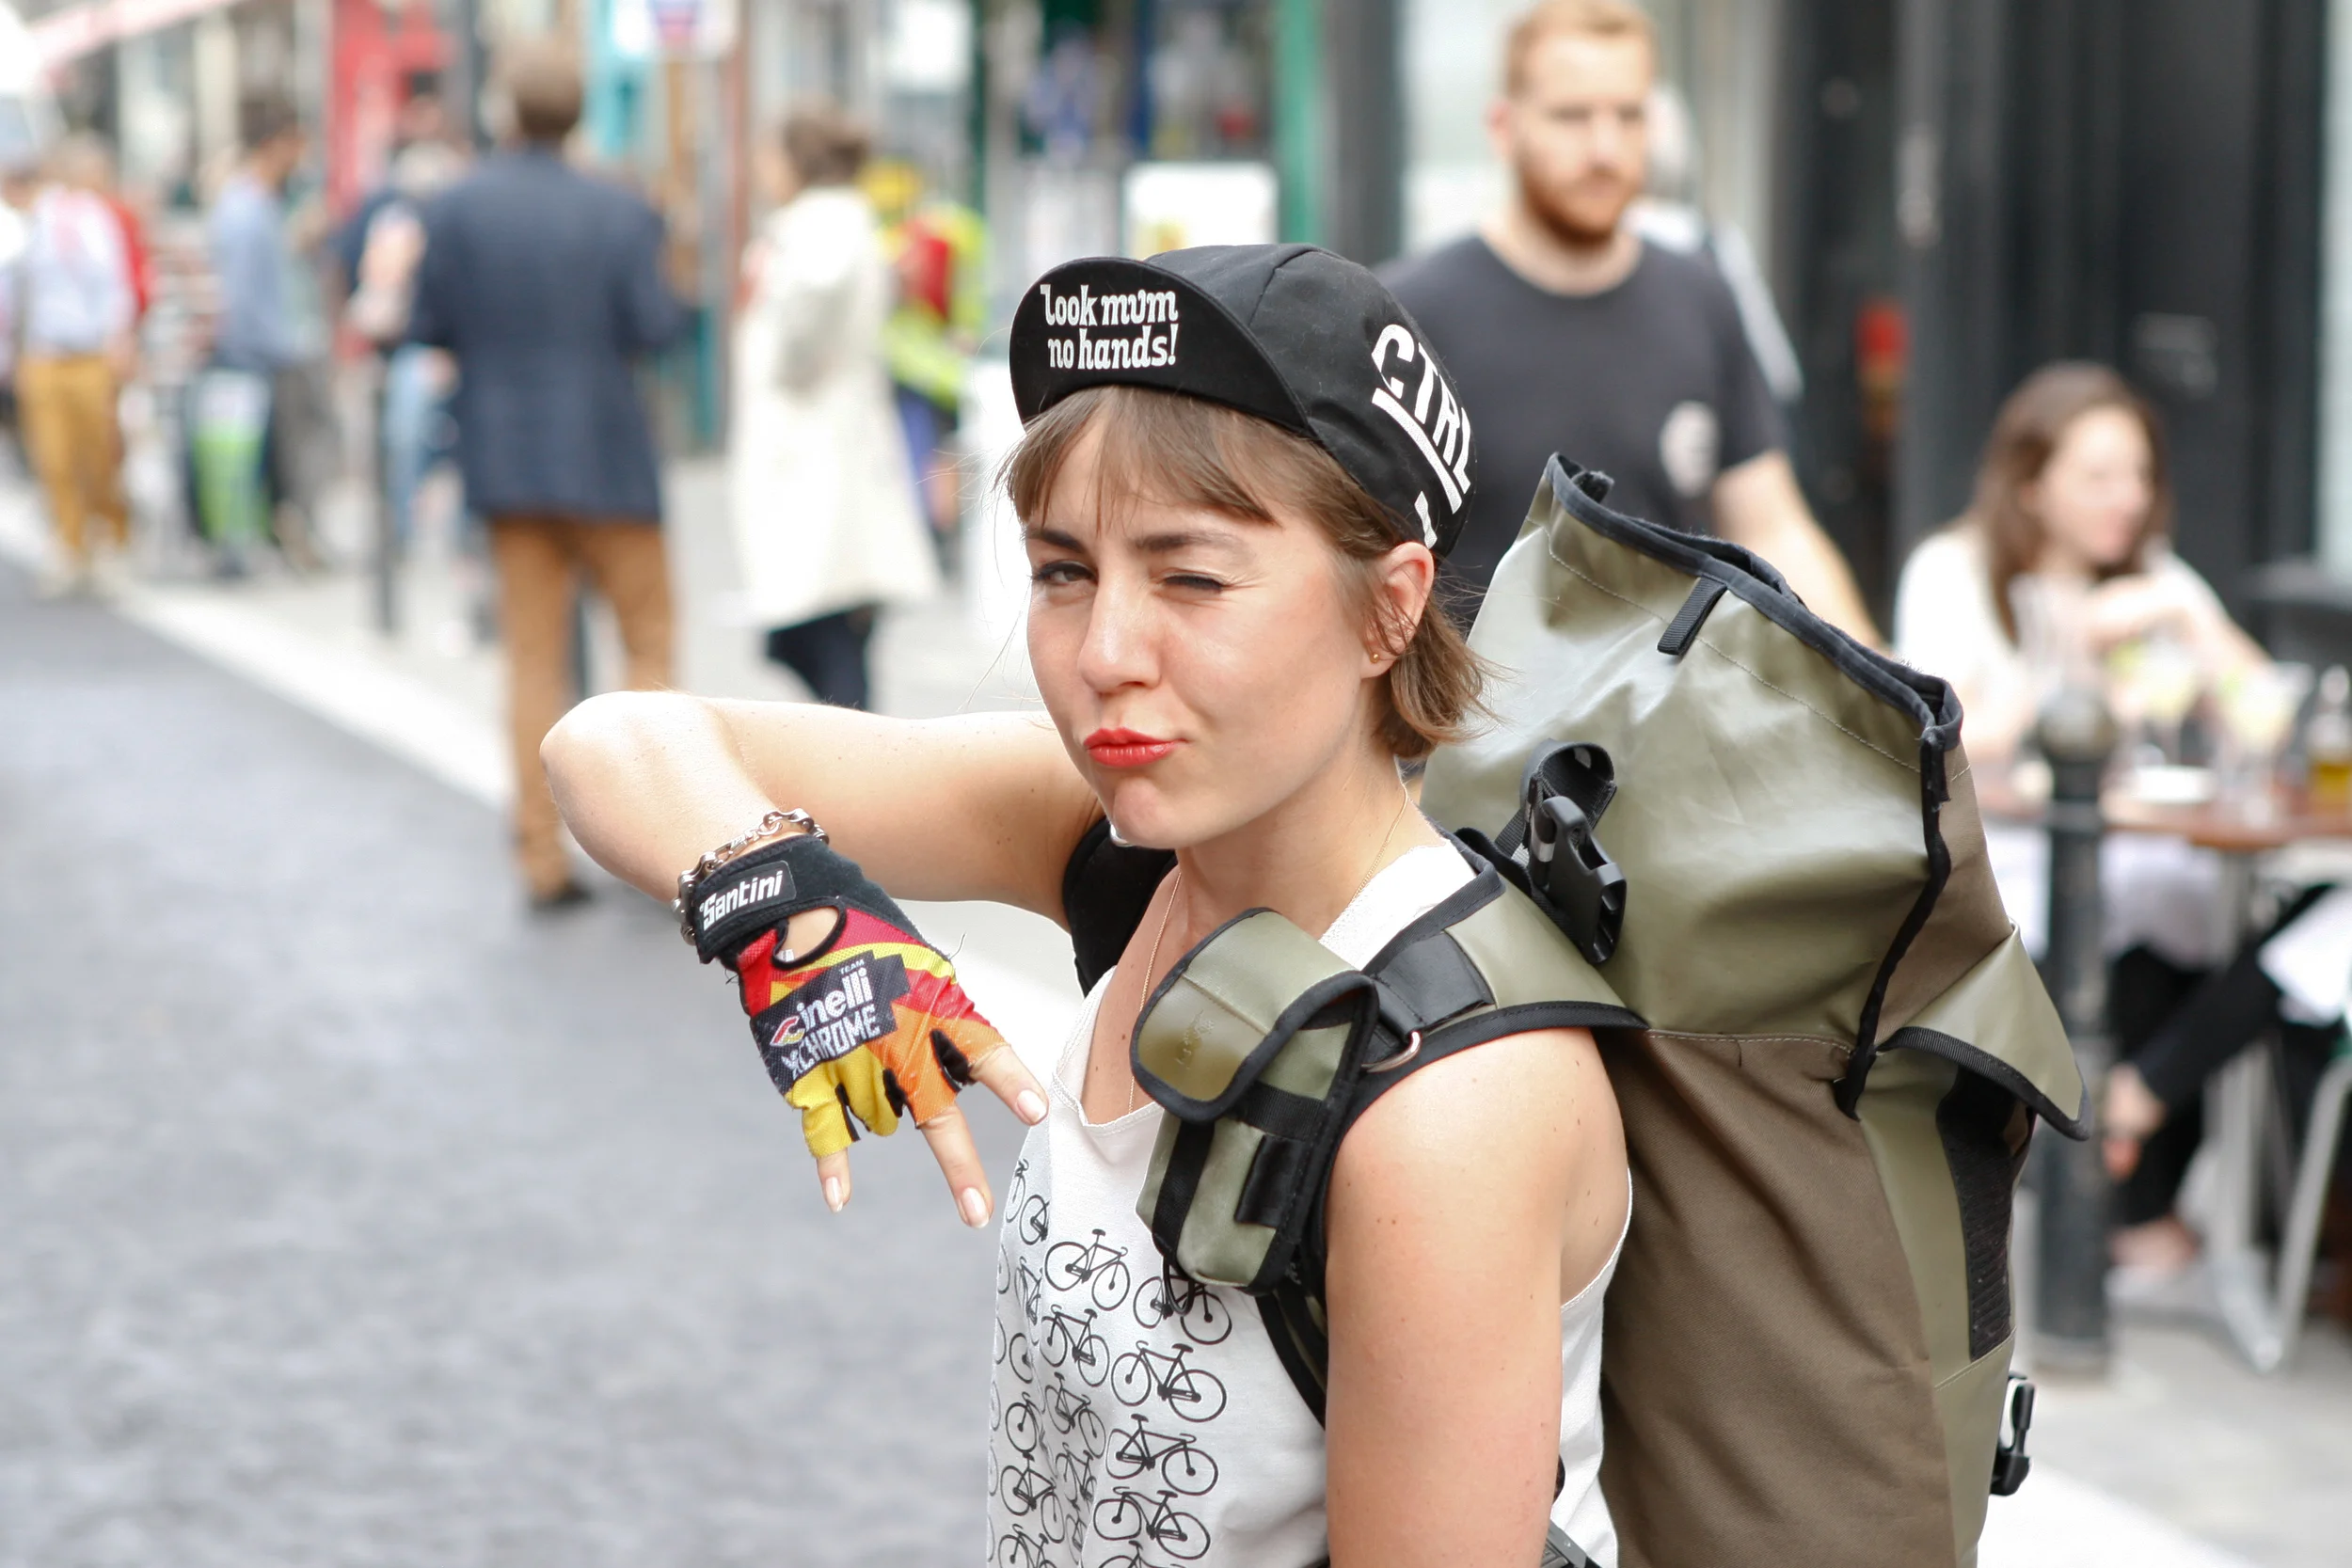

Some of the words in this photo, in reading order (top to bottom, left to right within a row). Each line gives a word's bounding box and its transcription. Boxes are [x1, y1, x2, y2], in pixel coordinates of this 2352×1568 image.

[1040, 283, 1099, 326] look
[1101, 289, 1179, 325] mum
[1047, 338, 1074, 369] no
[1077, 323, 1179, 370] hands!
[1371, 324, 1471, 495] CTRL
[700, 870, 784, 931] Santini
[838, 958, 865, 975] TEAM
[798, 1004, 881, 1075] CHROME
